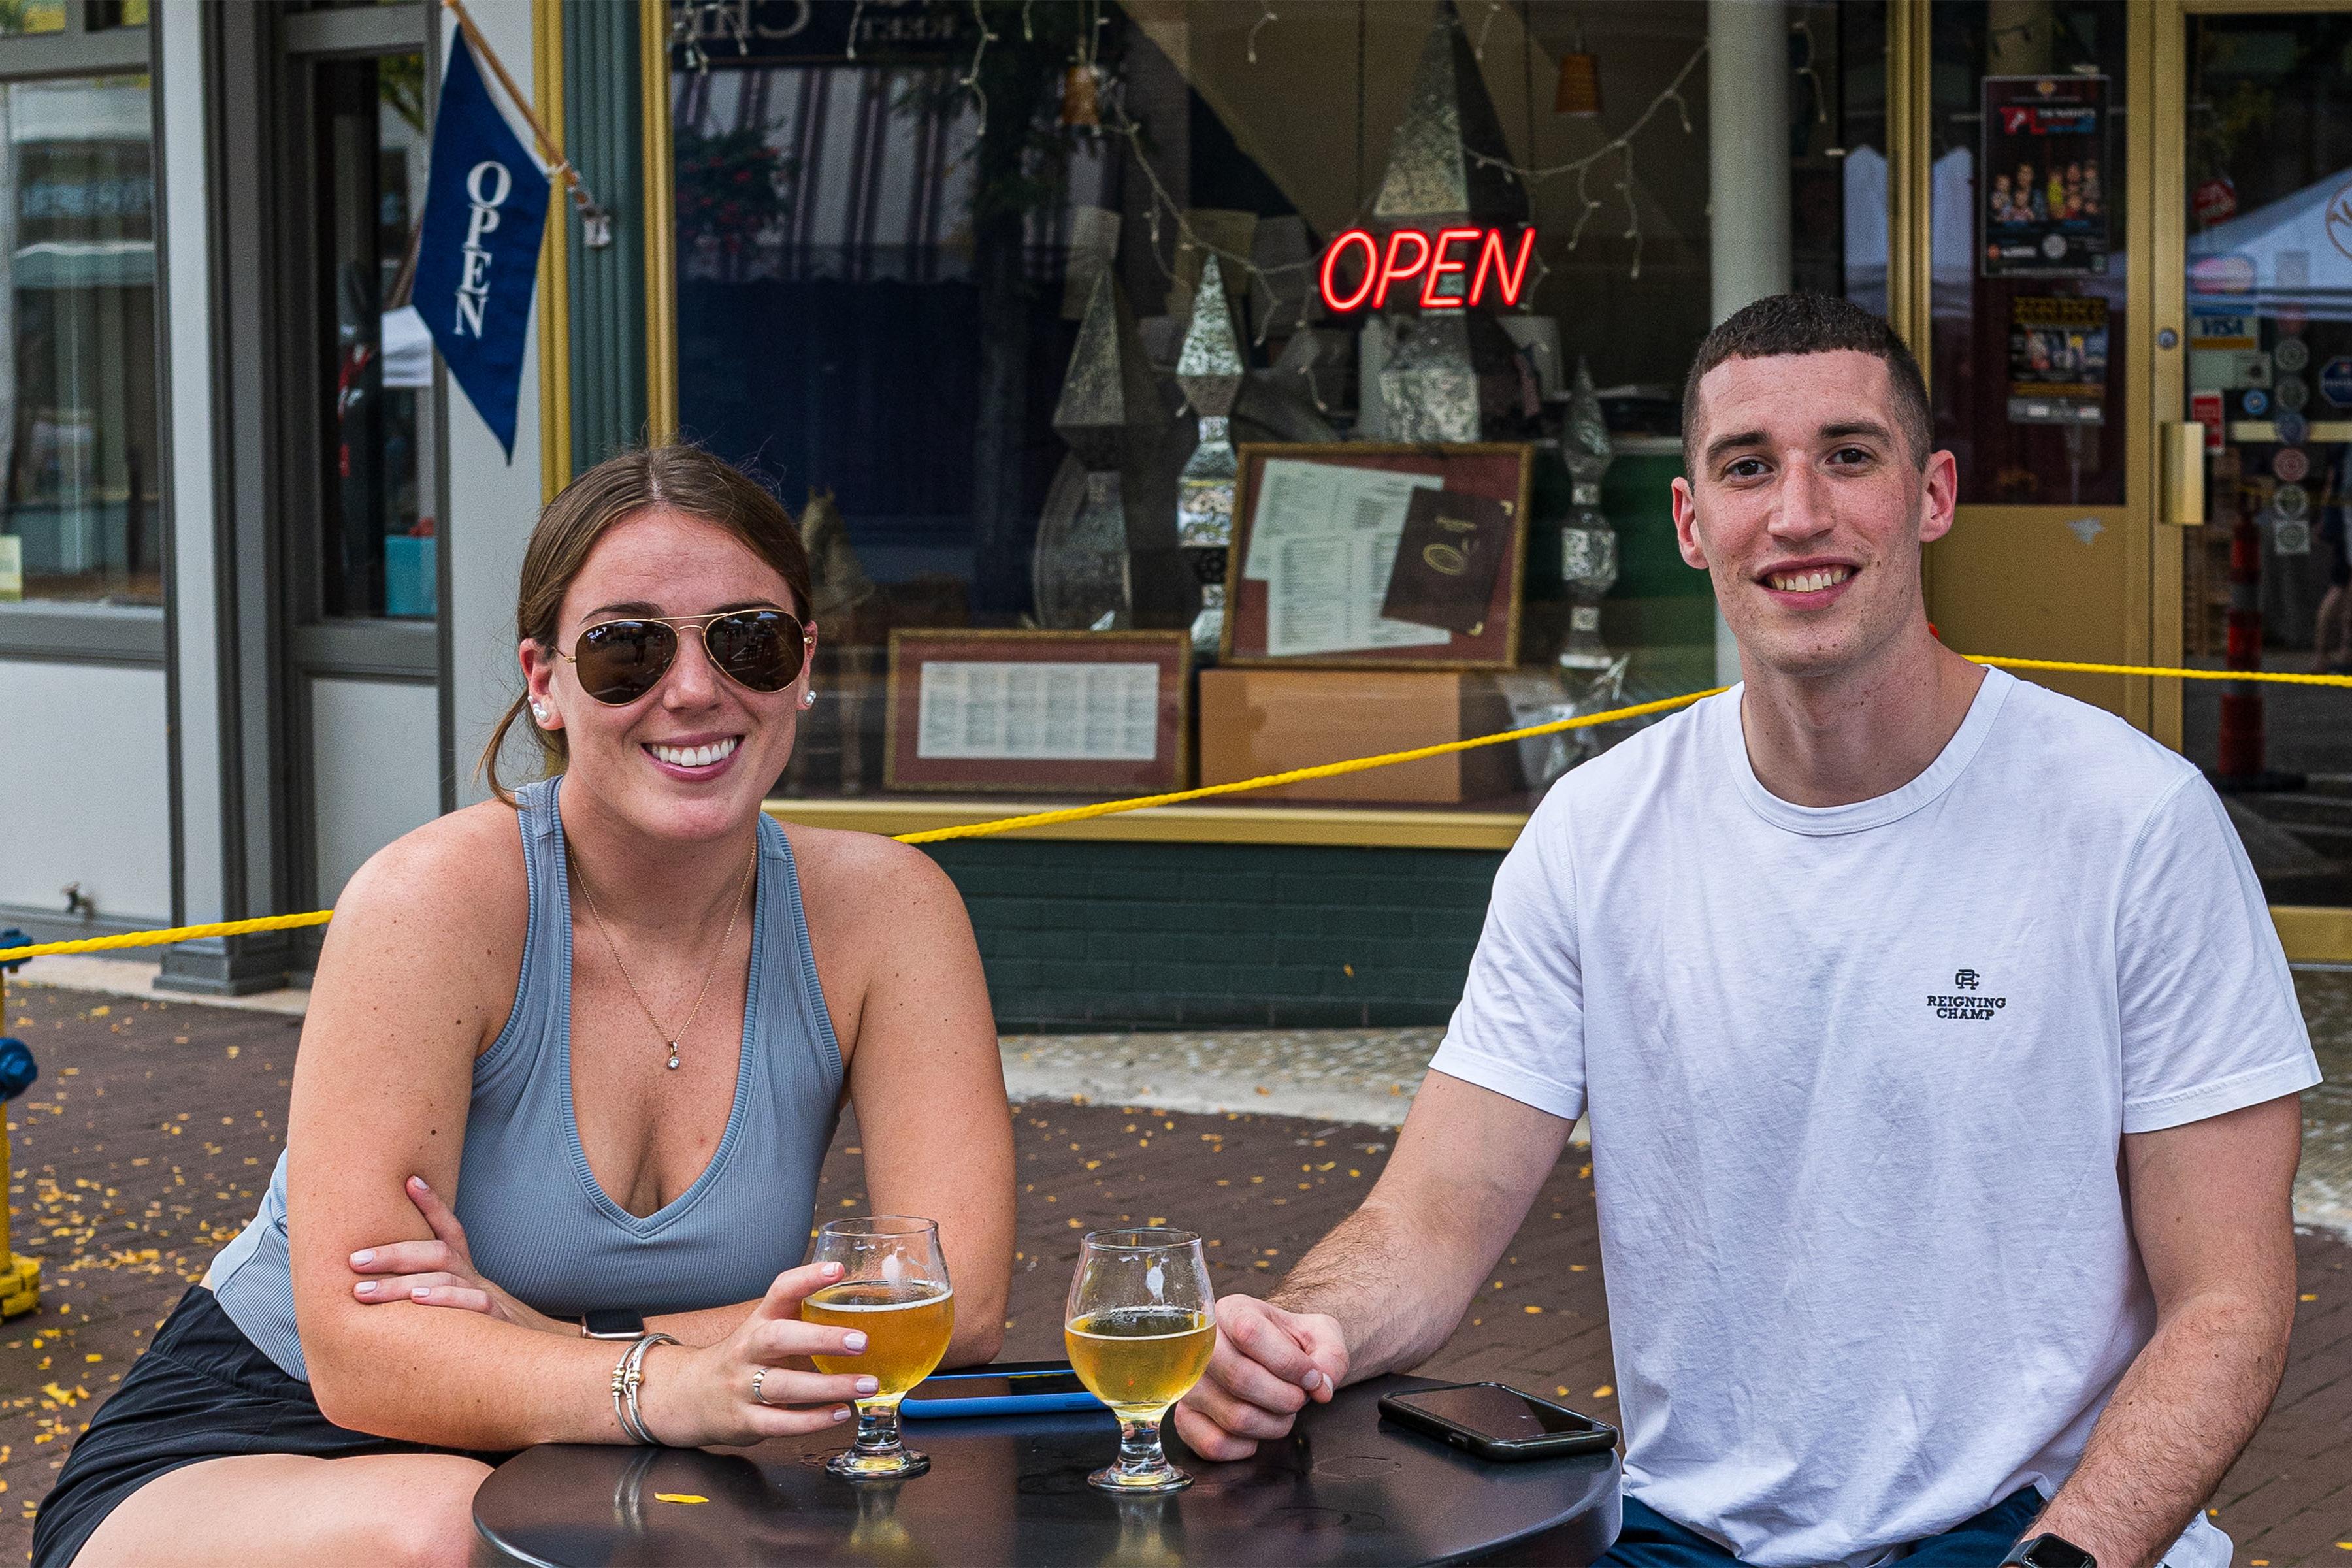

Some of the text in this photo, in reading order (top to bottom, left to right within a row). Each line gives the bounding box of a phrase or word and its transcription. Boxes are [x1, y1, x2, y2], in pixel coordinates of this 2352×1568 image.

[453, 161, 512, 339] OPEN
[1321, 227, 1535, 311] OPEN
[2202, 318, 2244, 335] VISA
[1927, 996, 2006, 1008] REIGNING
[1936, 1008, 1995, 1020] CHAMP
